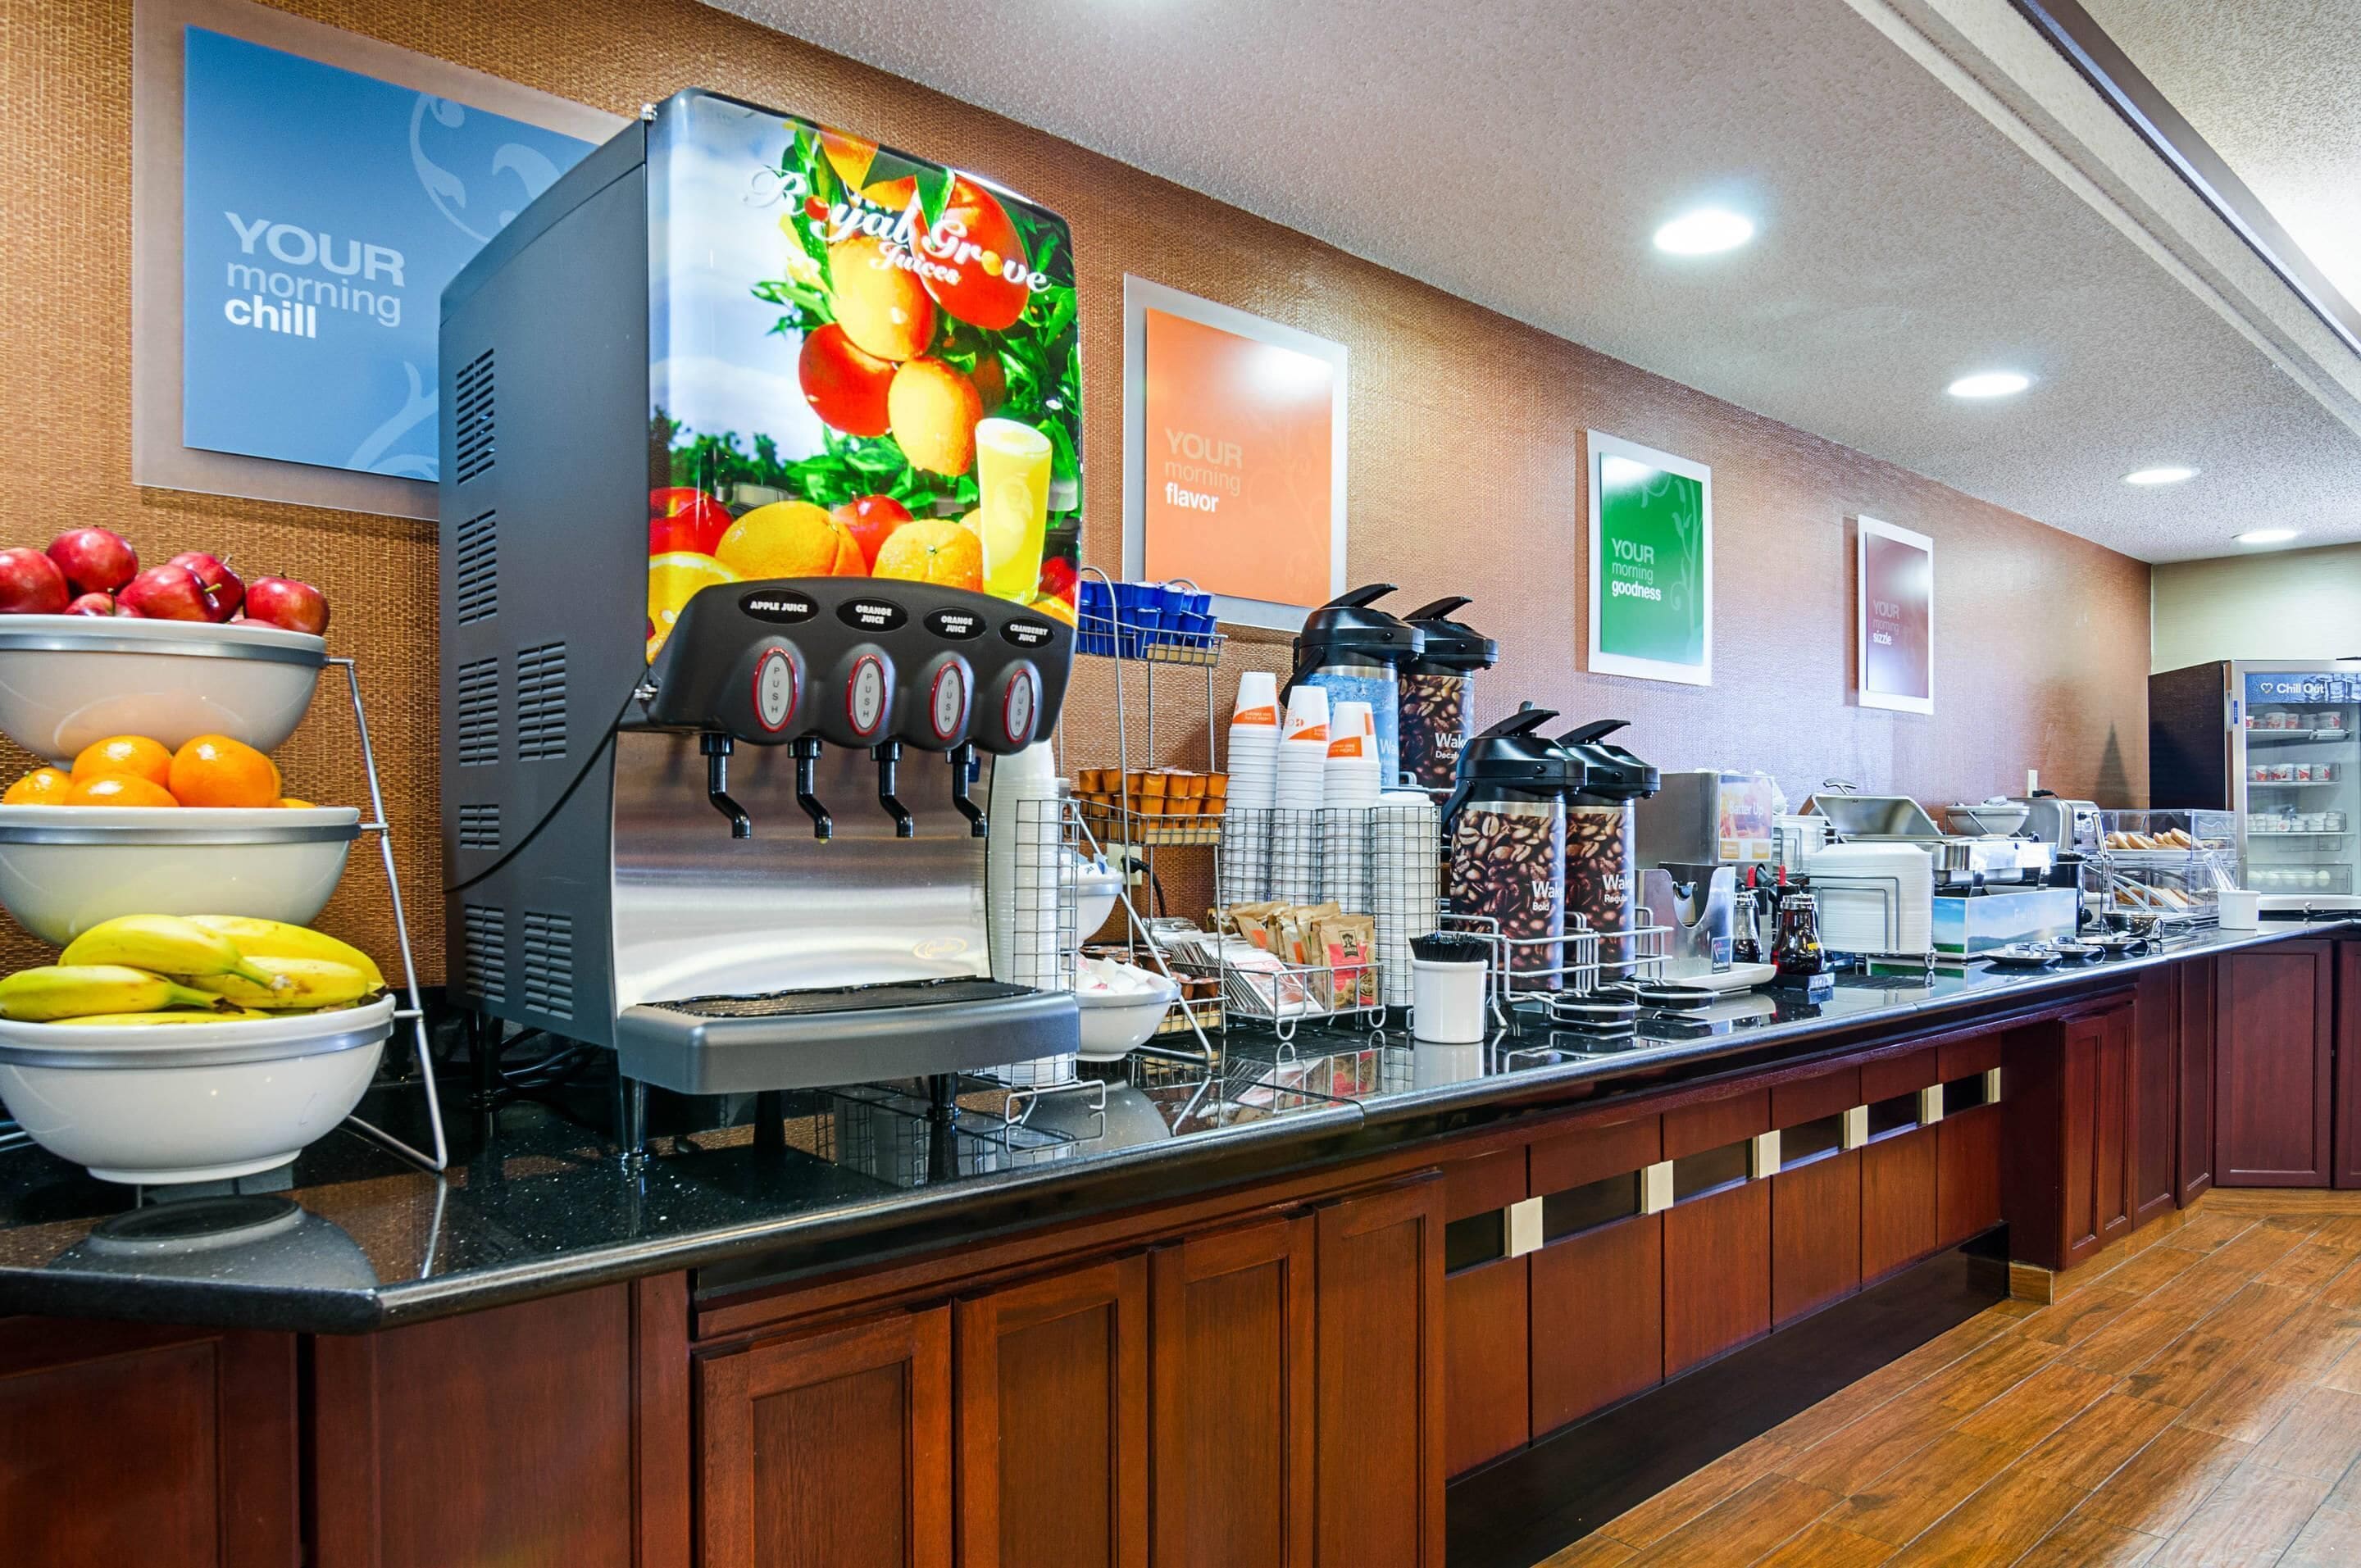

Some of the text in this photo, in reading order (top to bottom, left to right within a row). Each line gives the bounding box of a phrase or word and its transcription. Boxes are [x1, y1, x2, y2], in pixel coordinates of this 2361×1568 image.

[224, 211, 406, 288] YOUR
[867, 240, 963, 286] Juices
[226, 261, 402, 328] morning
[224, 294, 316, 339] chill
[1164, 426, 1243, 470] YOUR
[1164, 461, 1240, 498] morning
[1165, 481, 1220, 512] flavor
[1611, 537, 1654, 565] YOUR
[1612, 561, 1654, 585] morning
[1612, 579, 1662, 602] goodness
[750, 600, 808, 613] APPLE JUICE
[855, 604, 893, 616] ORANGE
[1872, 599, 1900, 620] YOUR
[861, 615, 885, 625] JUICE
[940, 615, 973, 625] ORANGE
[945, 625, 967, 634] JUICE
[1009, 624, 1049, 636] CRANBERRY
[1018, 633, 1037, 643] JUICE
[771, 666, 780, 713] PUSH
[863, 673, 873, 718] PUSH
[944, 679, 953, 722] PUSH
[2277, 682, 2325, 694] Chill Out
[1015, 685, 1025, 727] PUSH
[1532, 902, 1550, 911] Bold
